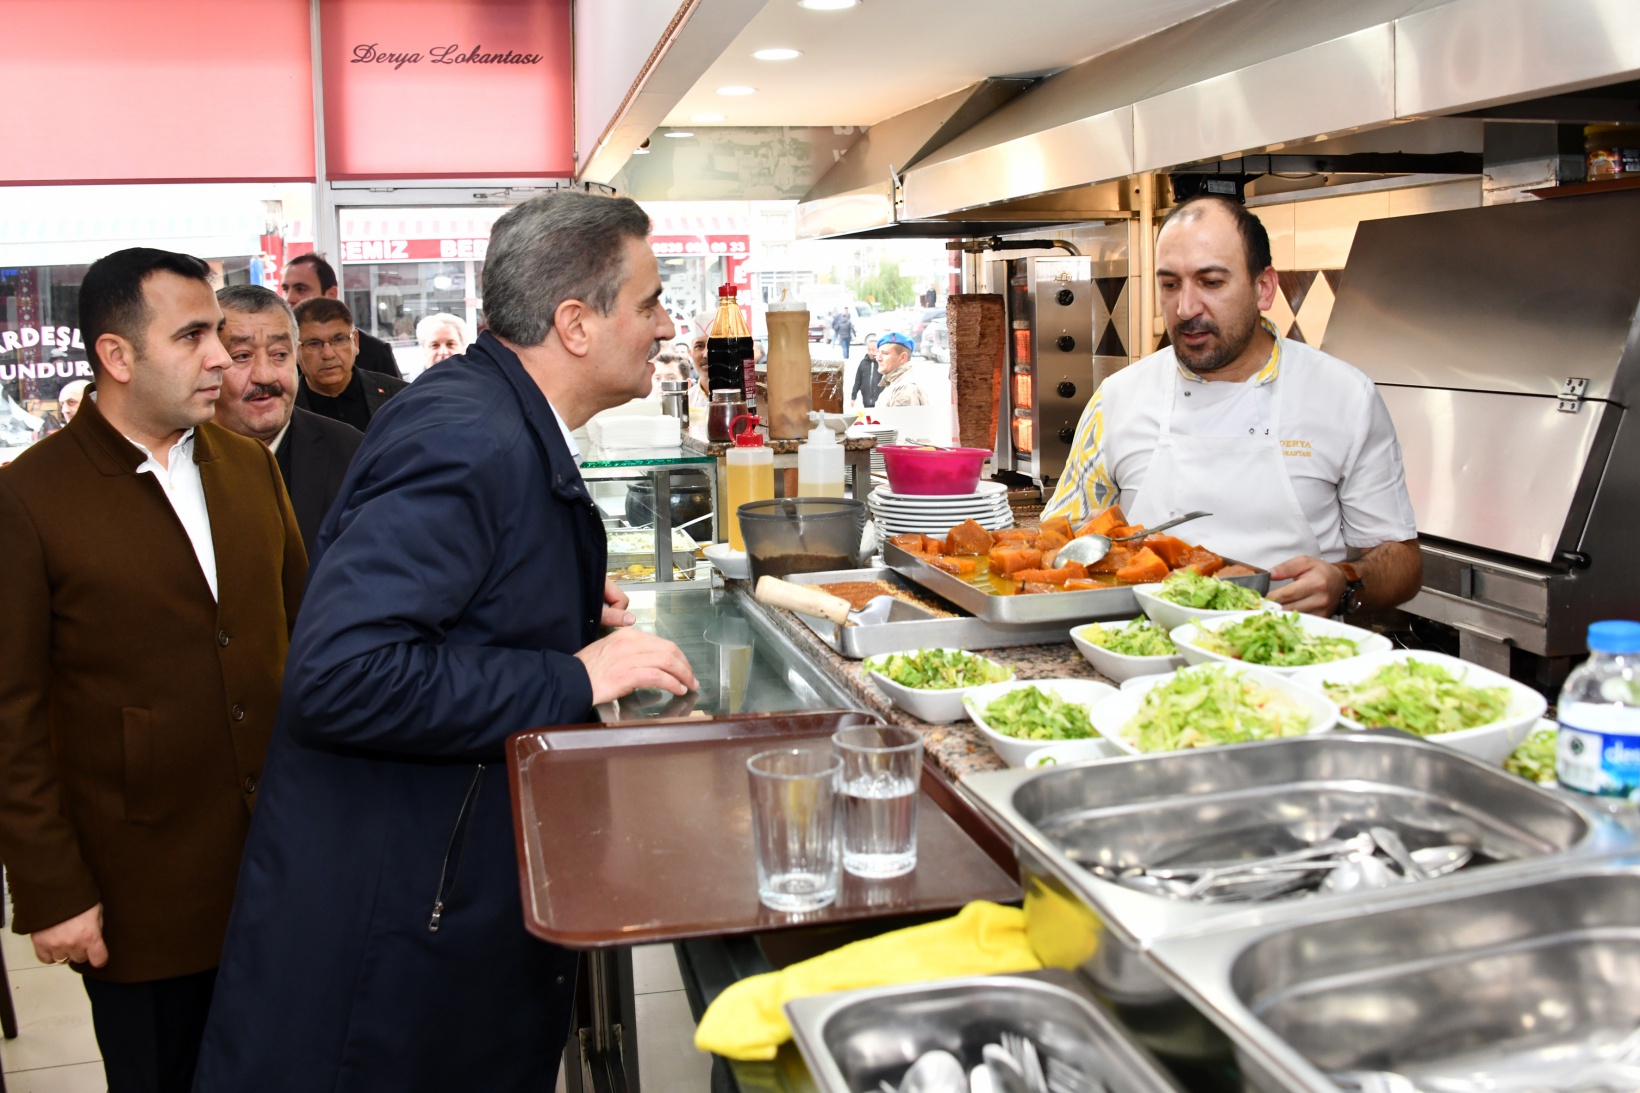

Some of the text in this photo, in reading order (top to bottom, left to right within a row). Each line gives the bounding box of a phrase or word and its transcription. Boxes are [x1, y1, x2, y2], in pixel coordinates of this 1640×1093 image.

[350, 43, 544, 70] Derya Lokantası
[0, 360, 94, 380] UNDUR
